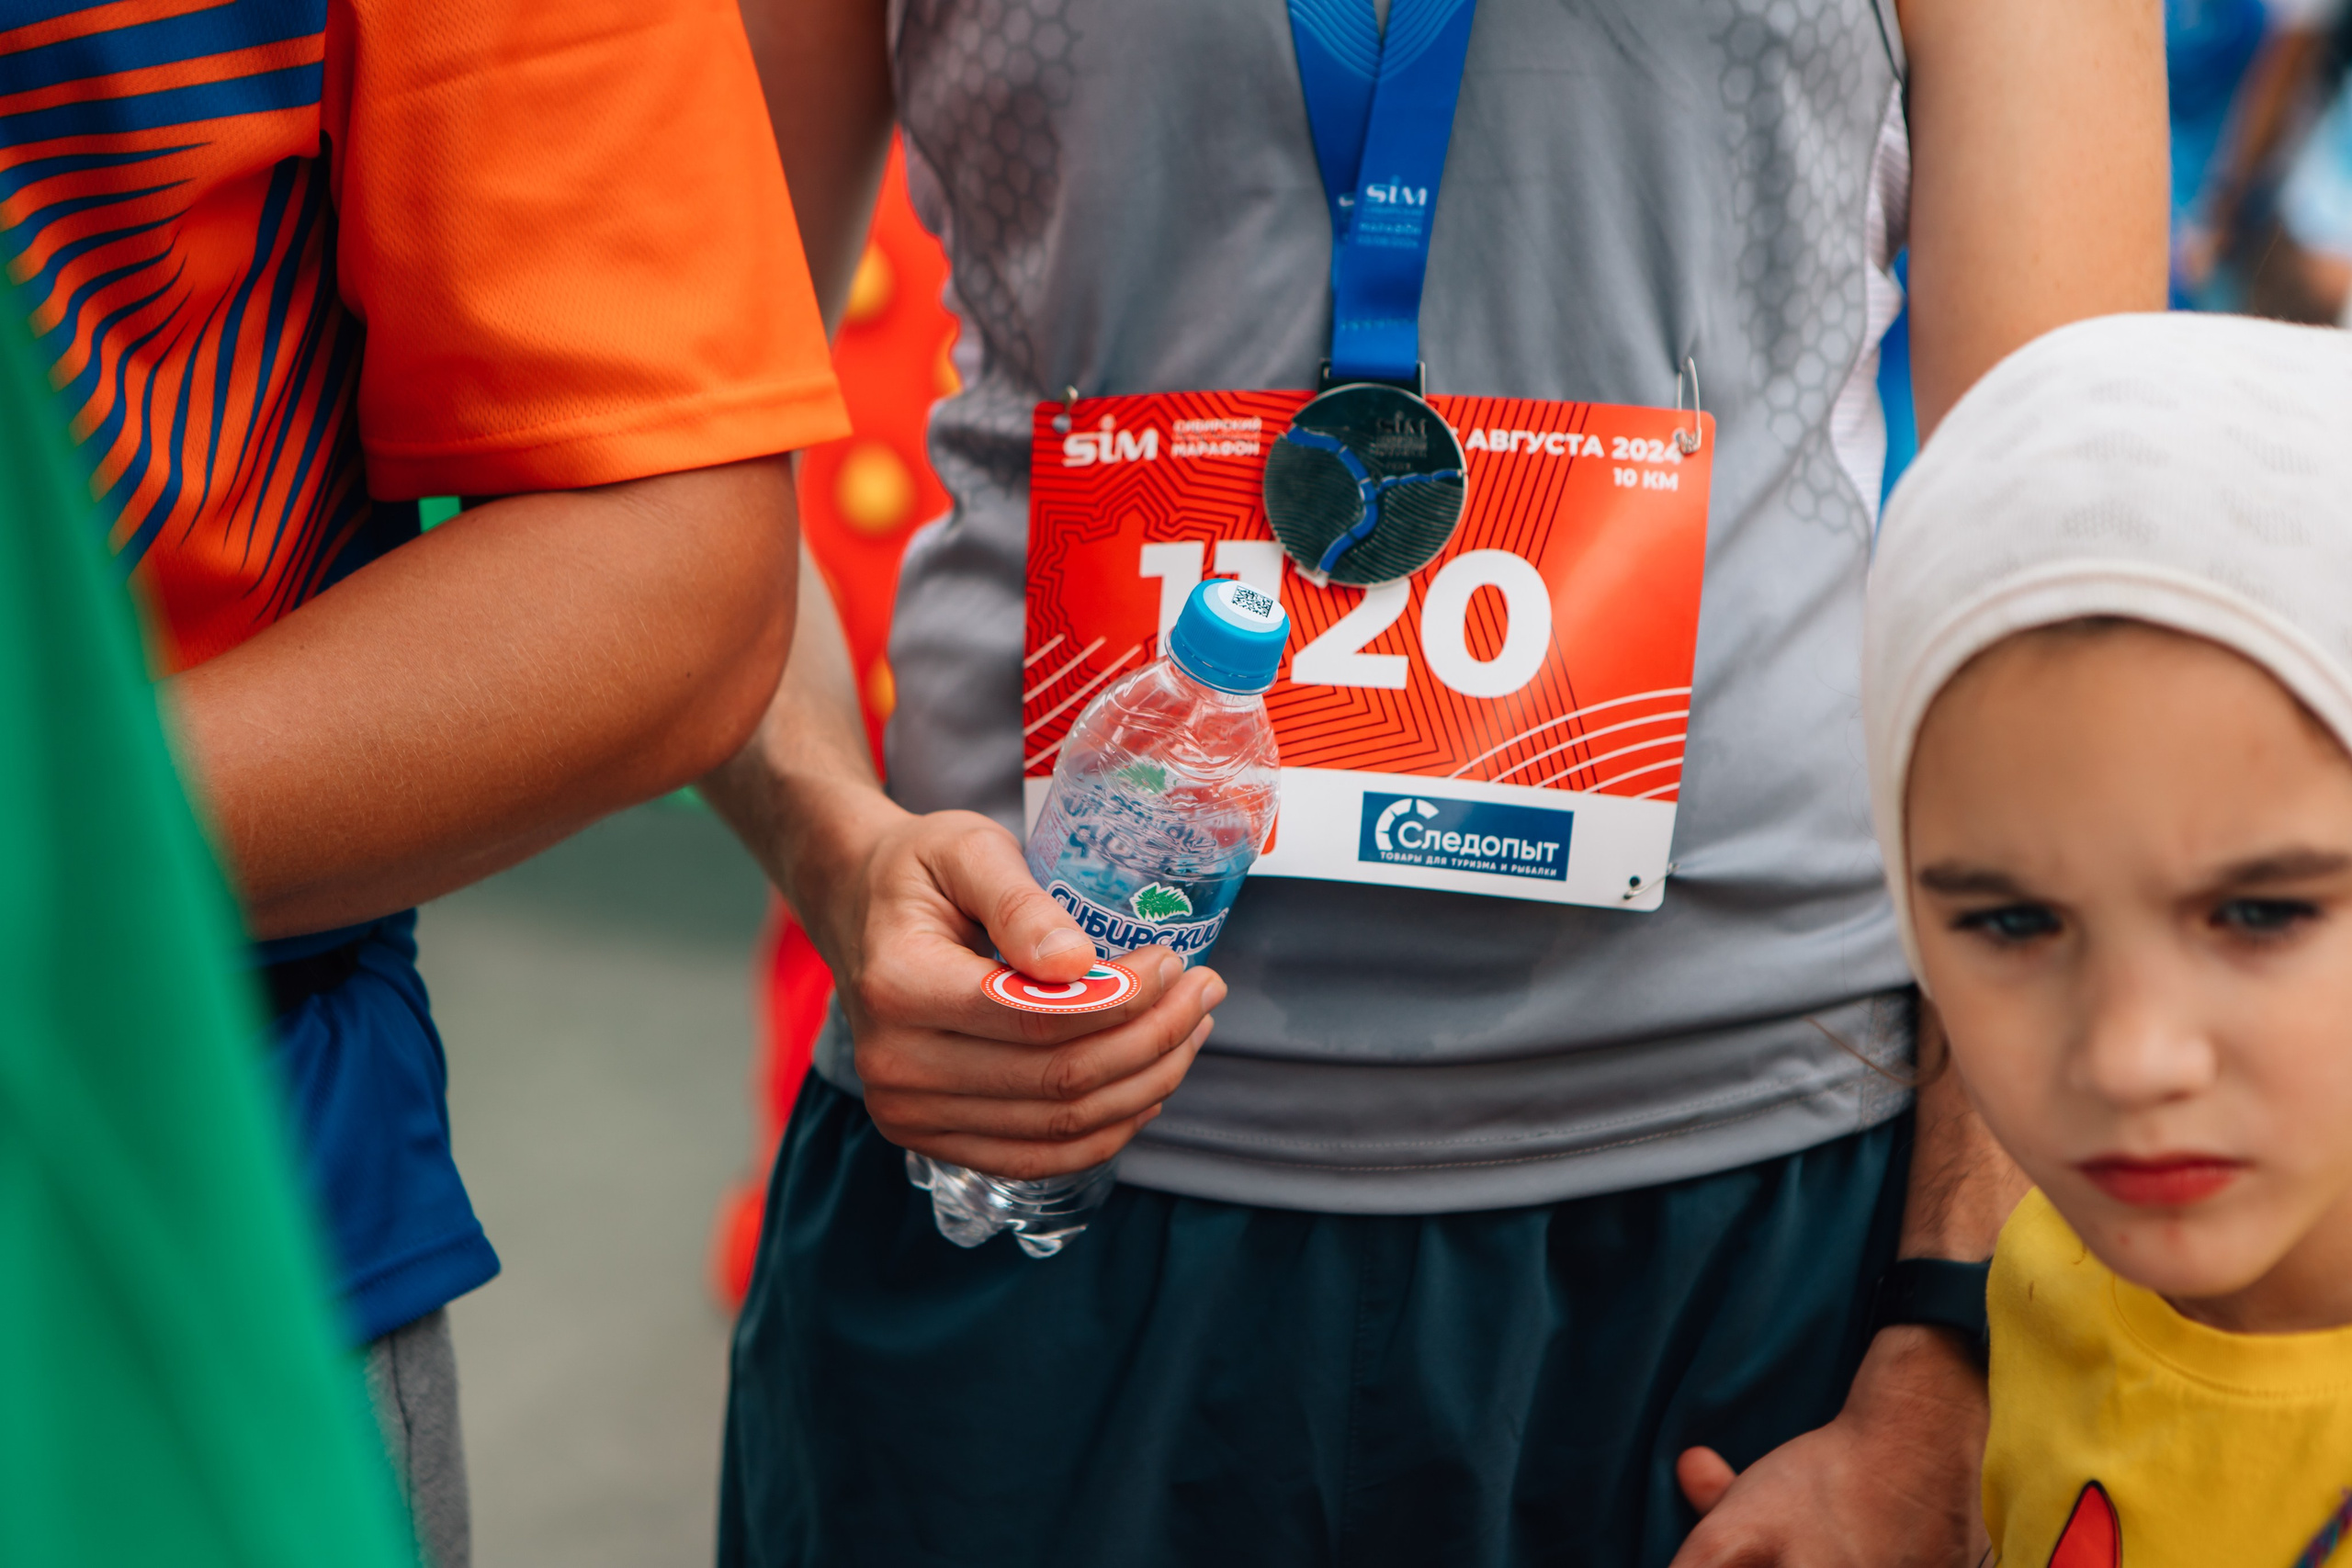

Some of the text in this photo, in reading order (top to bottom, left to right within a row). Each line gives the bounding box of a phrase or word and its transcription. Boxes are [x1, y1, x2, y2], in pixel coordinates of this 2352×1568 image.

[1171, 440, 1260, 458] МАРАФОН
[1464, 428, 1684, 466] АВГУСТА 2024
[1613, 467, 1679, 491] 10 КМ
[1397, 820, 1560, 863] Следопыт
[1380, 851, 1557, 877] ТОВАРЫ ДЛЯ ТУРИЗМА И РЫБАЛКИ
